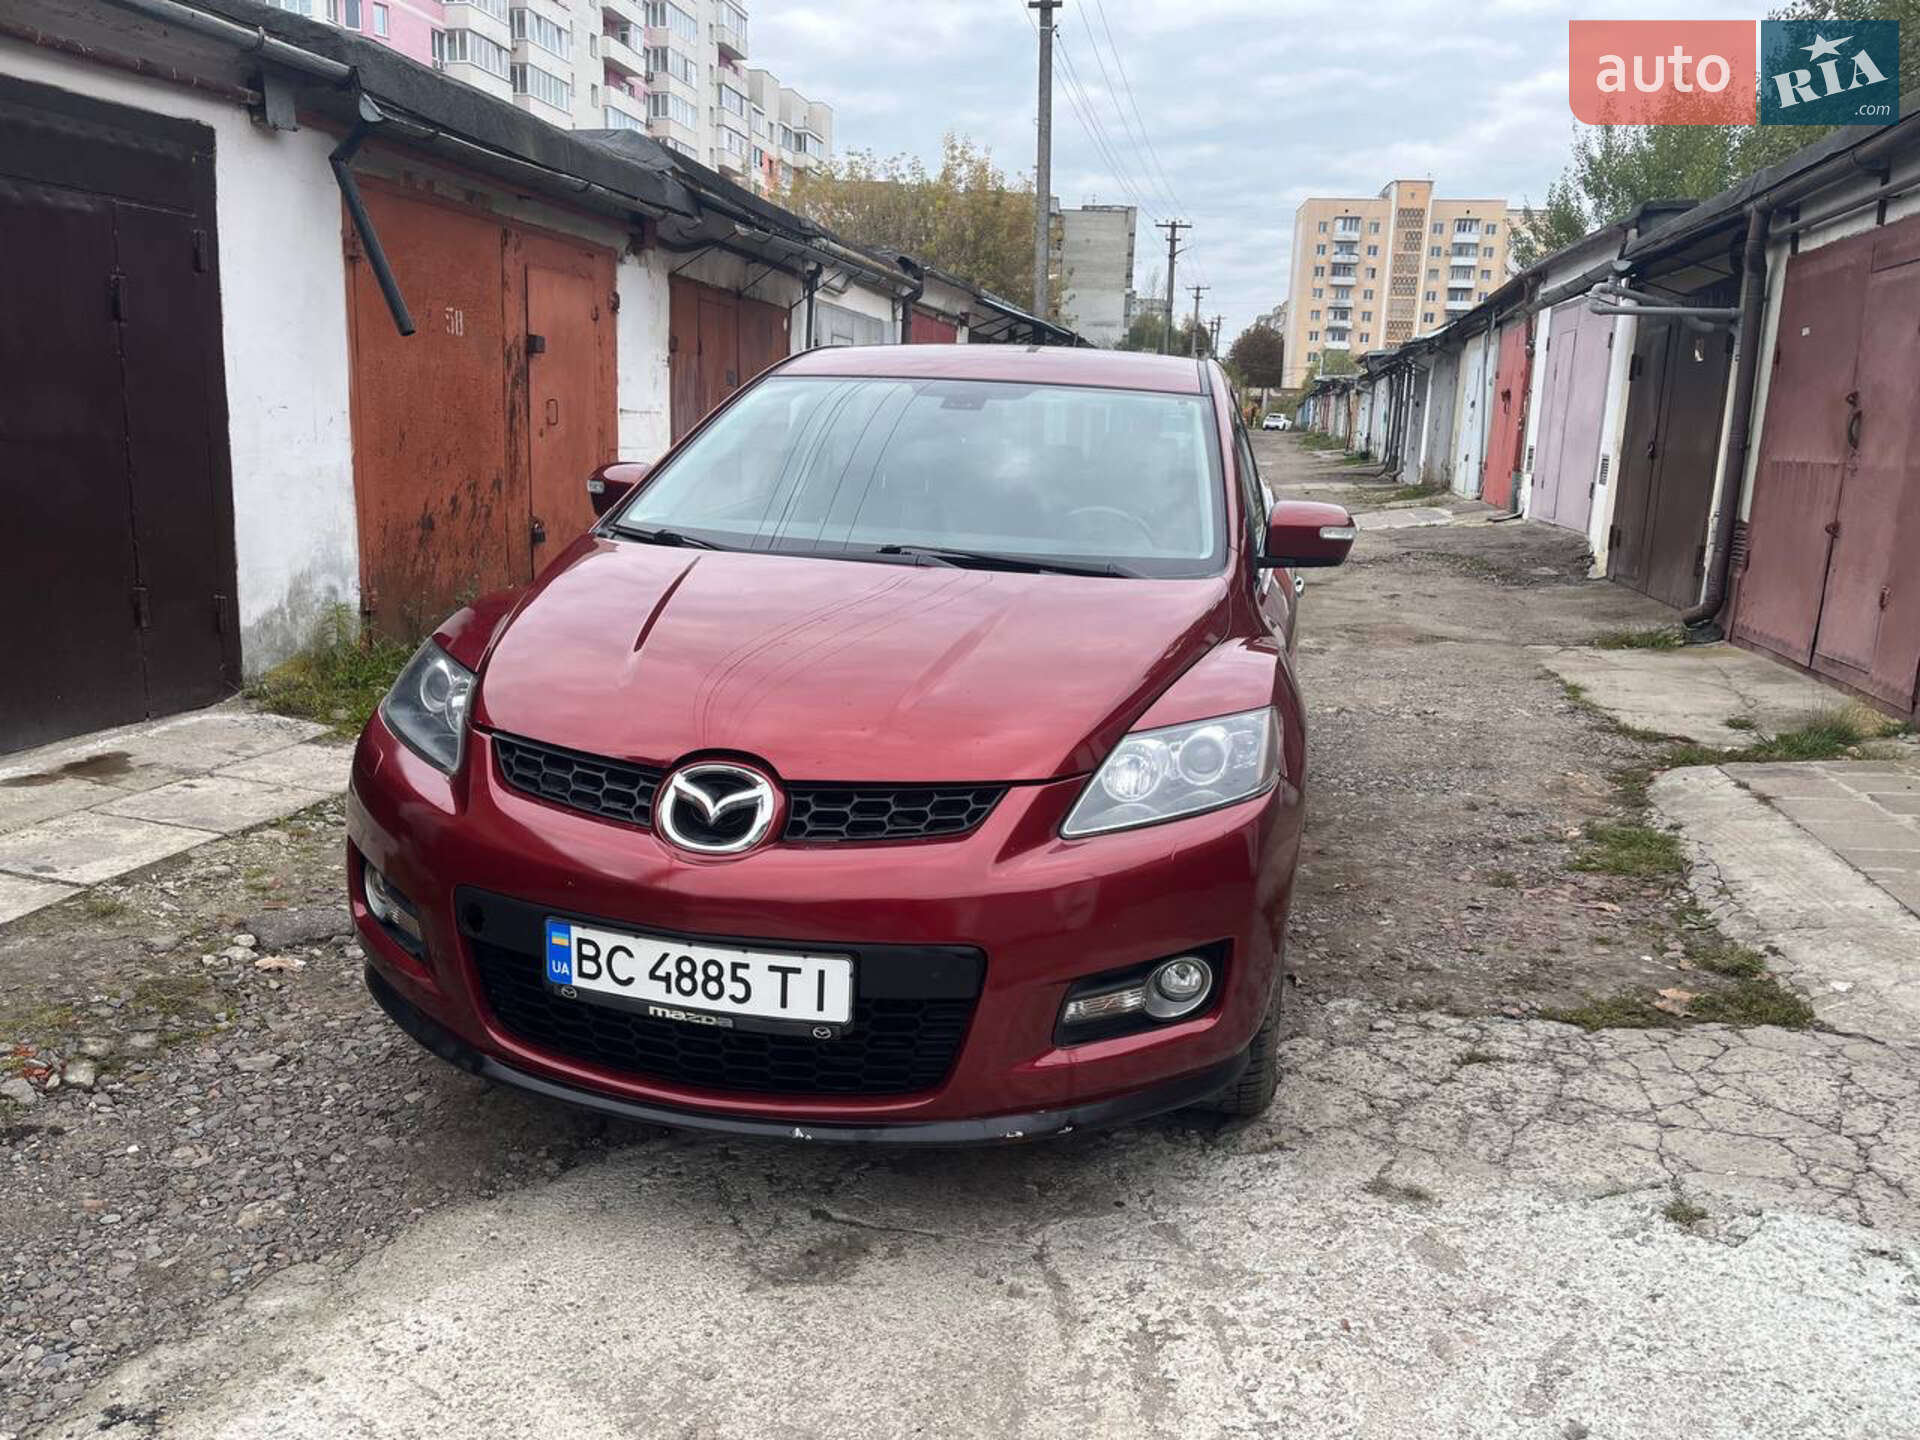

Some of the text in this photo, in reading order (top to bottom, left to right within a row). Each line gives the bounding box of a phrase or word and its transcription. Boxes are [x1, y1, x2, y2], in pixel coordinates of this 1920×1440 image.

[552, 960, 570, 975] UA
[577, 937, 826, 1012] BC 4885 TI
